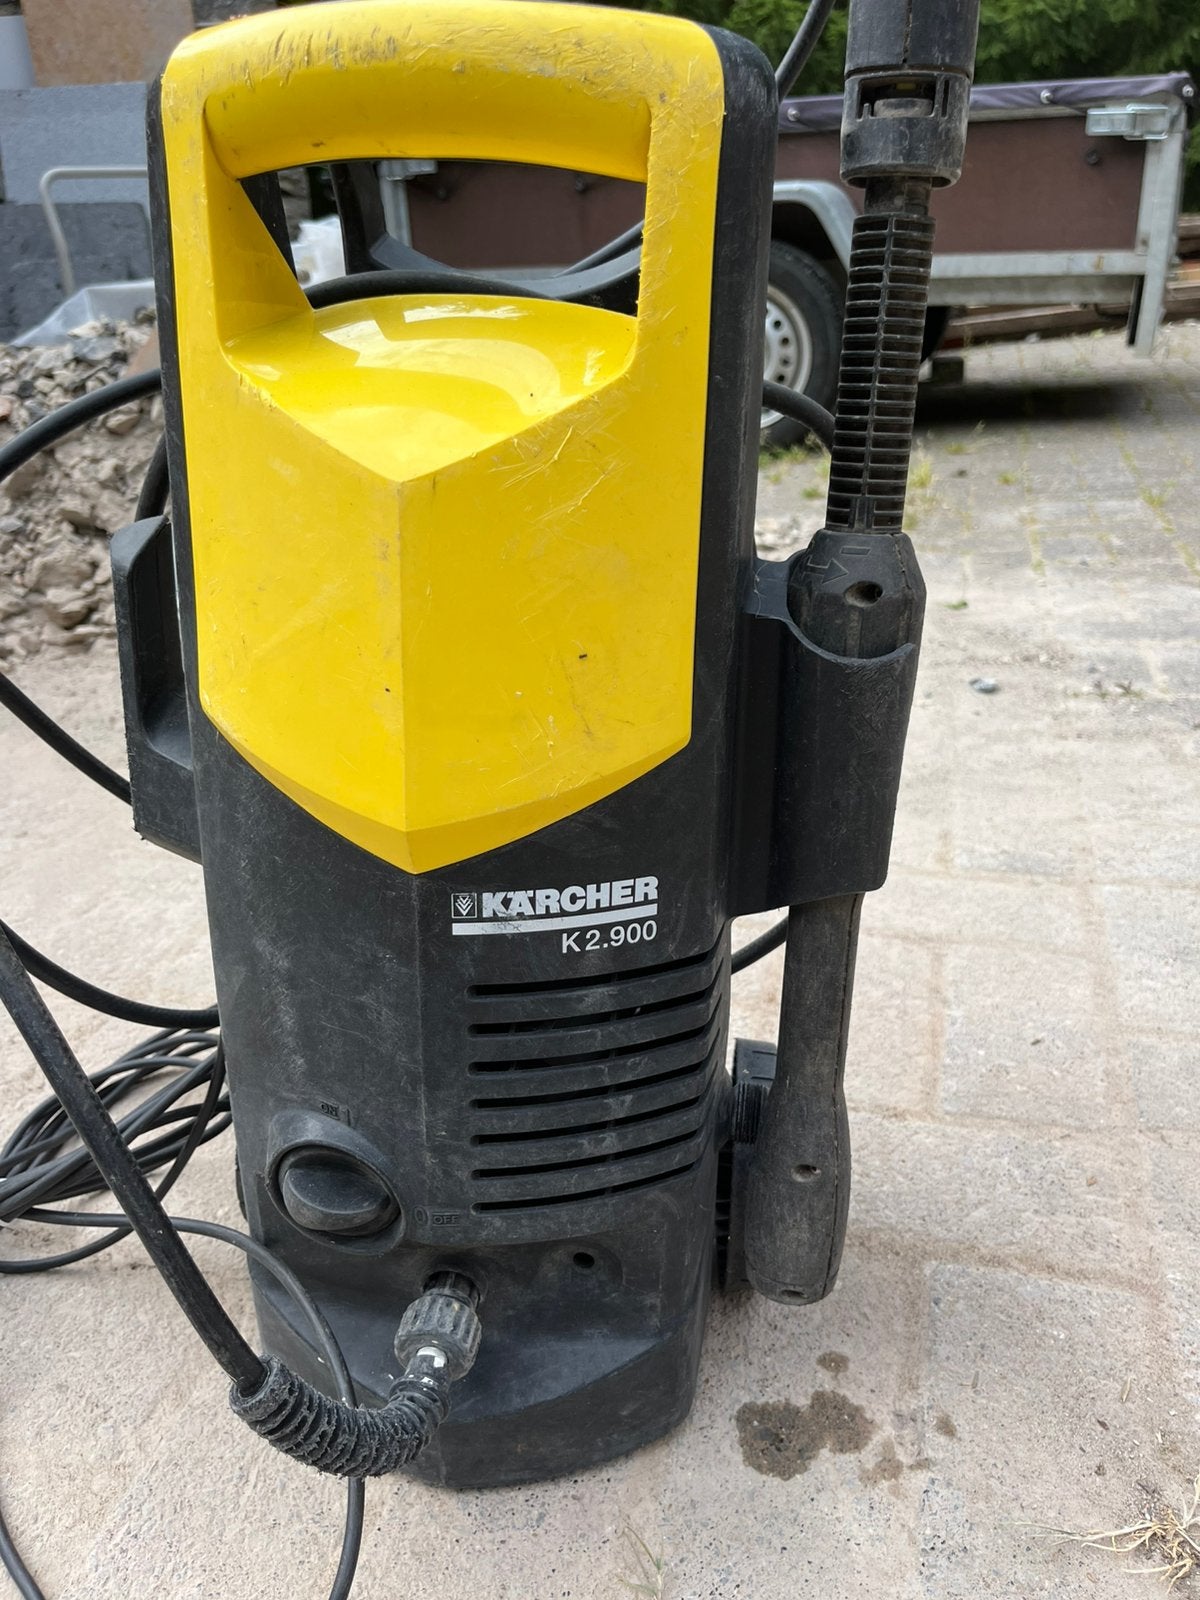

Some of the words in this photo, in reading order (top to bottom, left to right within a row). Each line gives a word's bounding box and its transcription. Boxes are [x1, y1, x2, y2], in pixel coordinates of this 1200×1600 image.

[482, 876, 659, 918] KÄRCHER
[320, 1102, 339, 1118] ON
[433, 1214, 459, 1225] OFF
